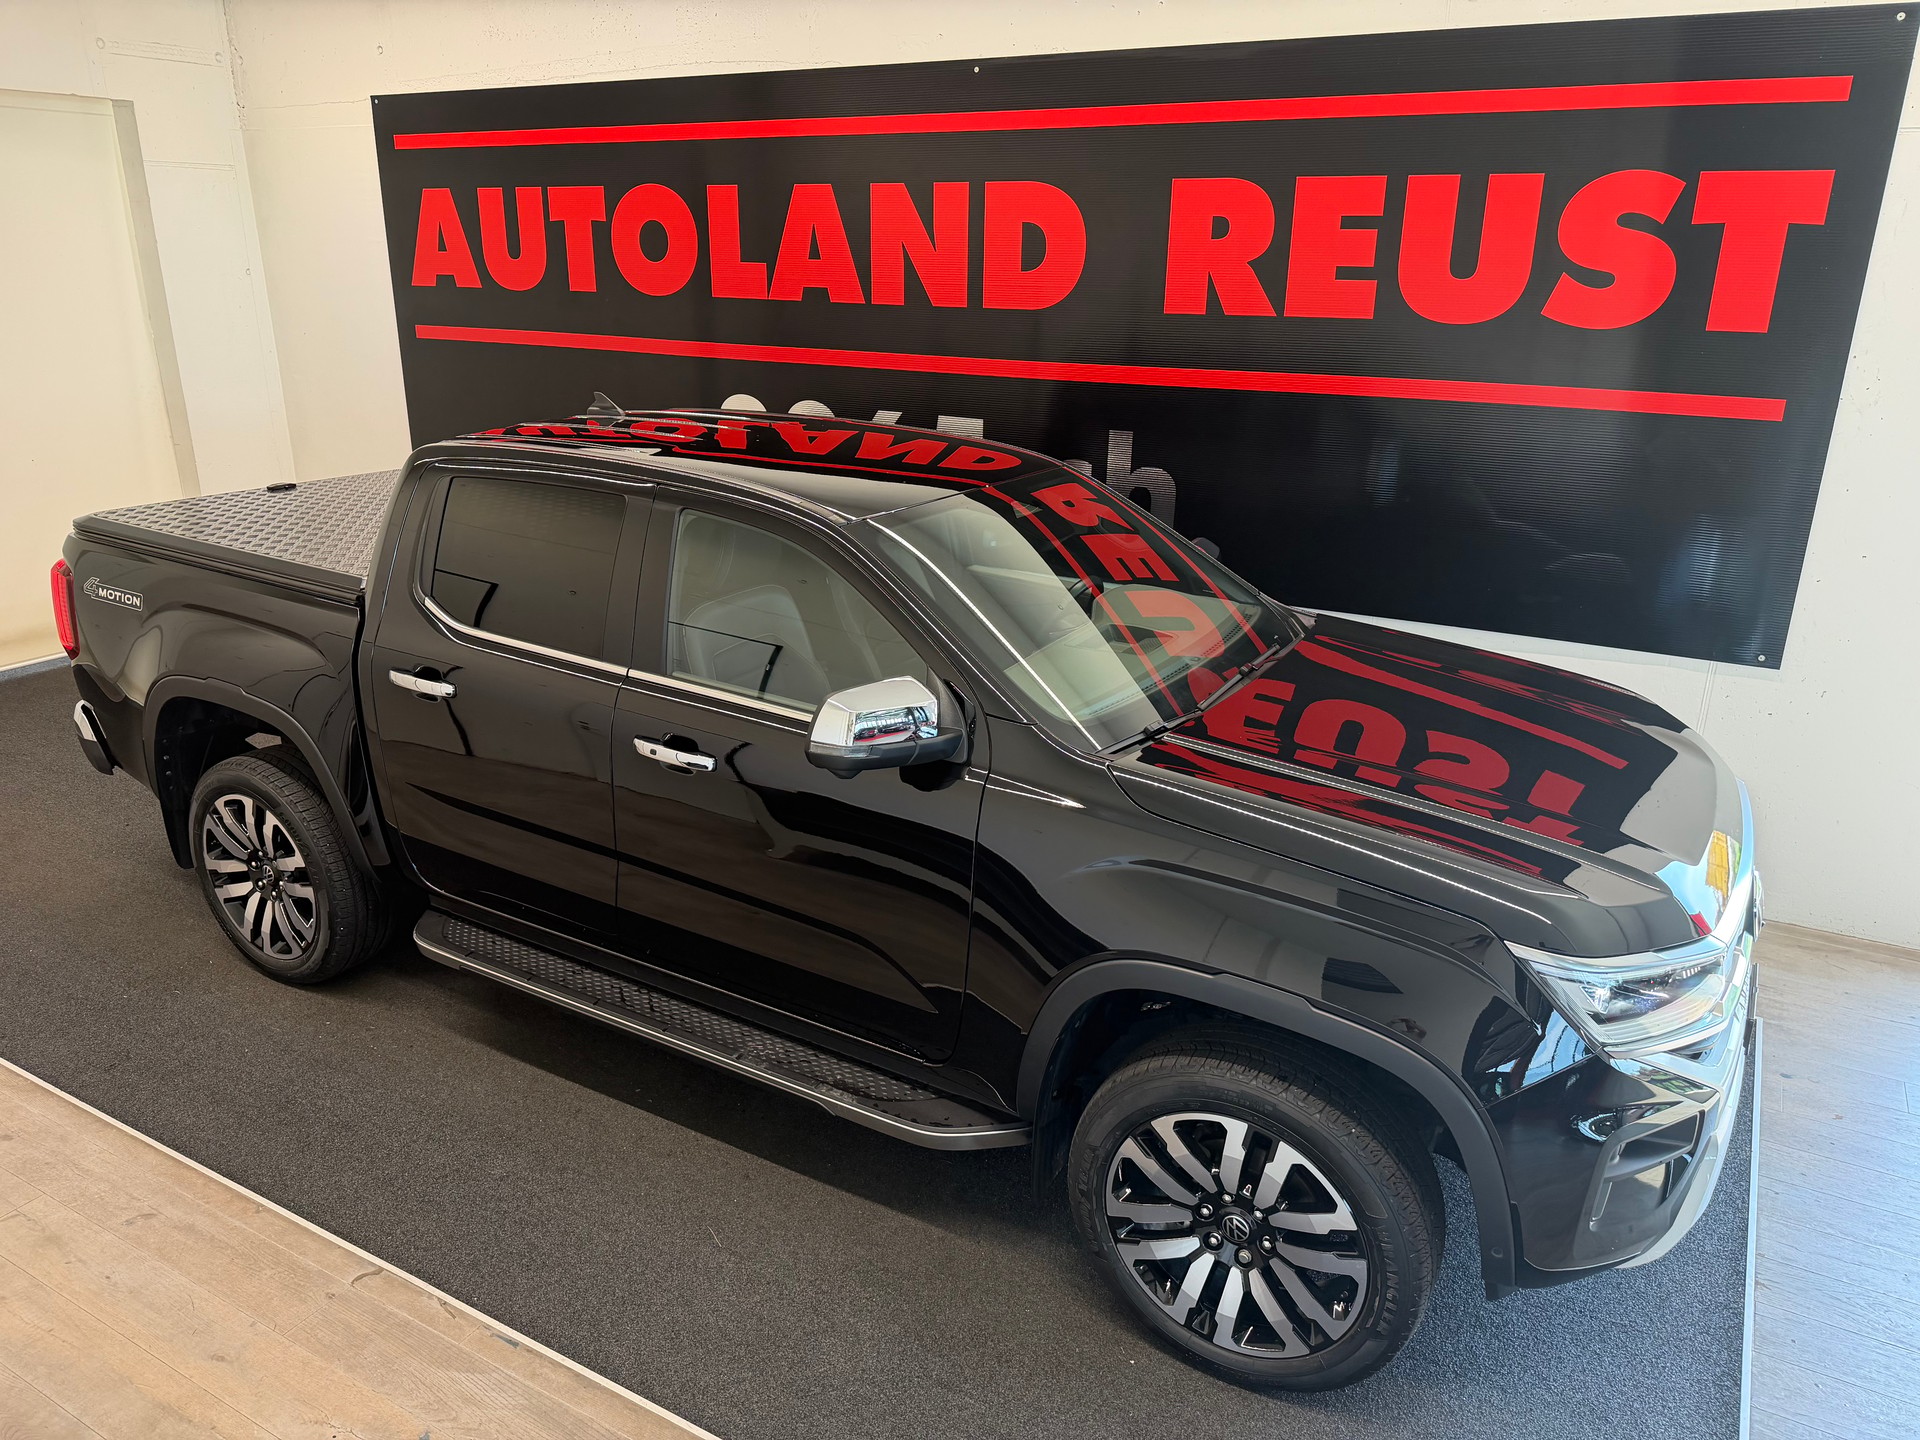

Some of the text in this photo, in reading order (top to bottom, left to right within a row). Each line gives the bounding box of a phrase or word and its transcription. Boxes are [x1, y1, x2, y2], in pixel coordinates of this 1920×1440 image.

[413, 170, 1834, 333] AUTOLAND REUST
[84, 577, 141, 607] 4MOTION
